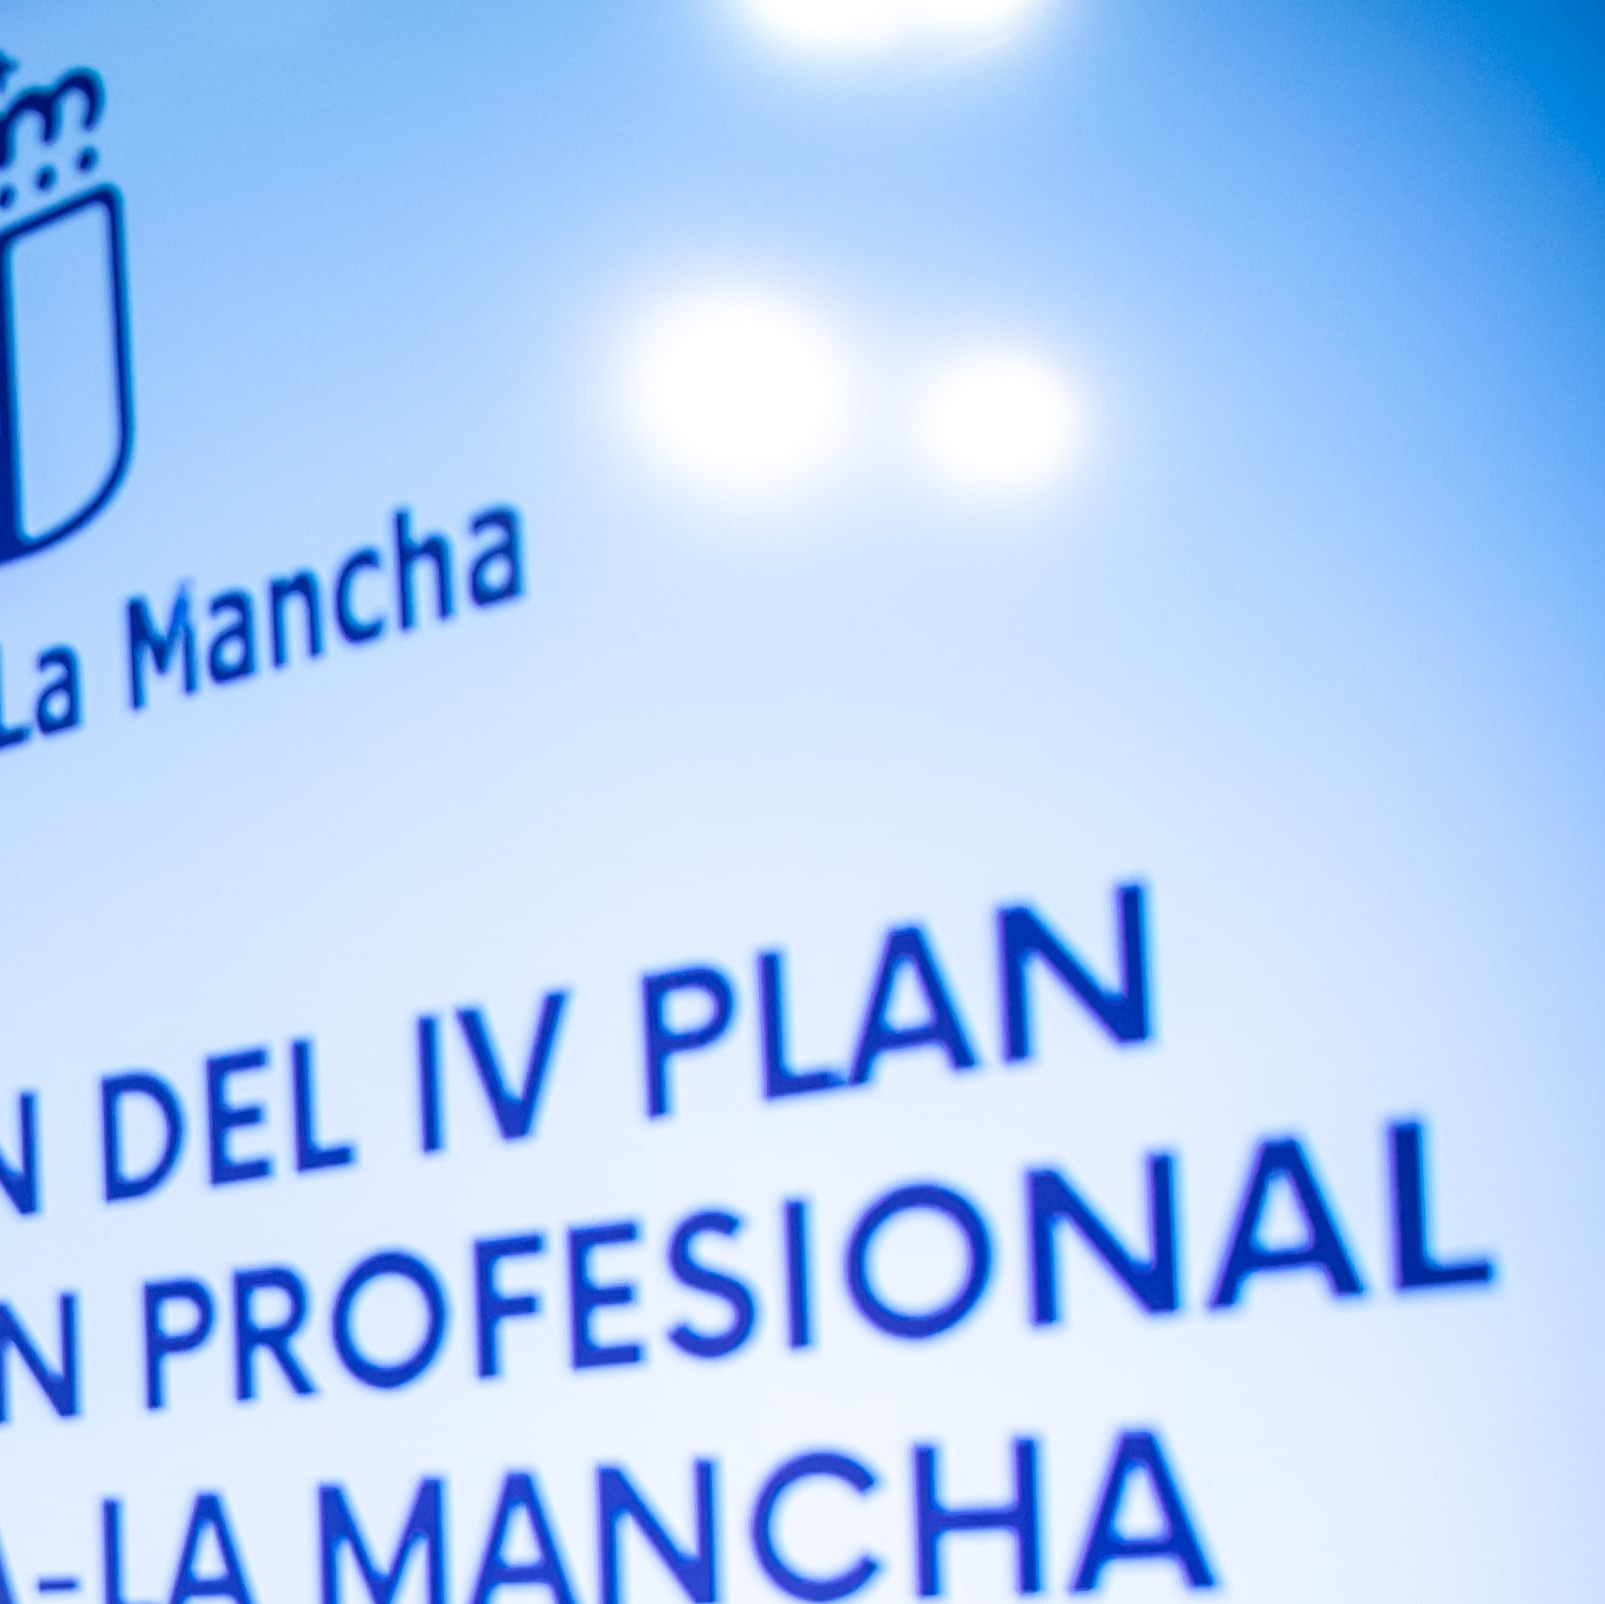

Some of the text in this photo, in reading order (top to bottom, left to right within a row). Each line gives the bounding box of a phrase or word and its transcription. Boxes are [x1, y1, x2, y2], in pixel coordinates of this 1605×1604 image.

[123, 501, 528, 713] Mancha
[98, 1036, 359, 1205] DEL
[415, 987, 573, 1156] IV
[639, 878, 1159, 1122] PLAN
[140, 1113, 1501, 1413] PROFESIONAL
